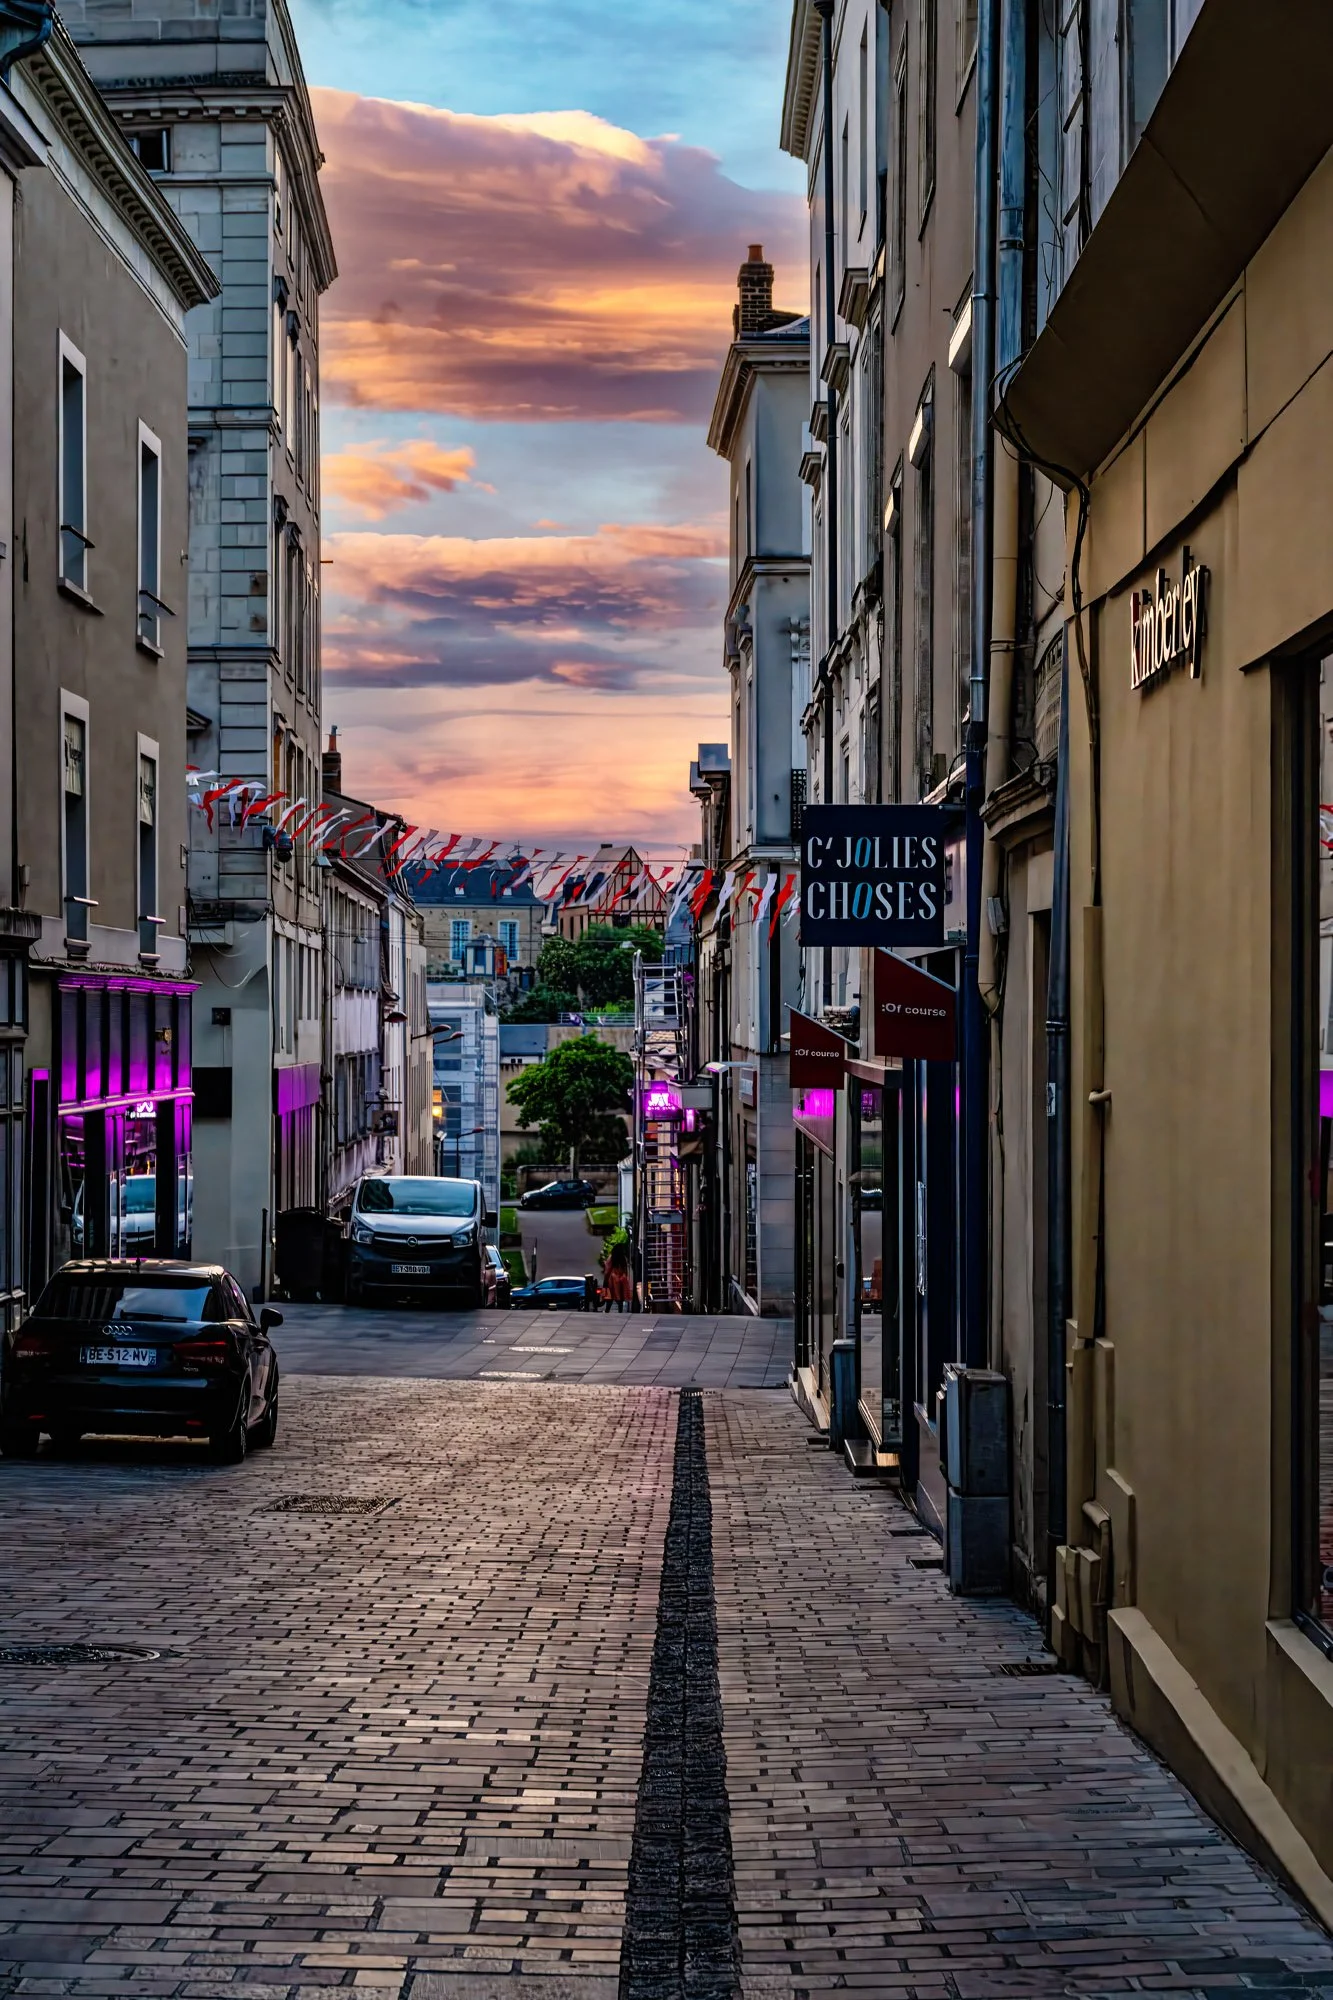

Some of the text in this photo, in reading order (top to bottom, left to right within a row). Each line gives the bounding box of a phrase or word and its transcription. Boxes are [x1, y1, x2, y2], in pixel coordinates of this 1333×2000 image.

[807, 882, 937, 920] CHOSES
[905, 1007, 947, 1017] course
[811, 1050, 840, 1058] course
